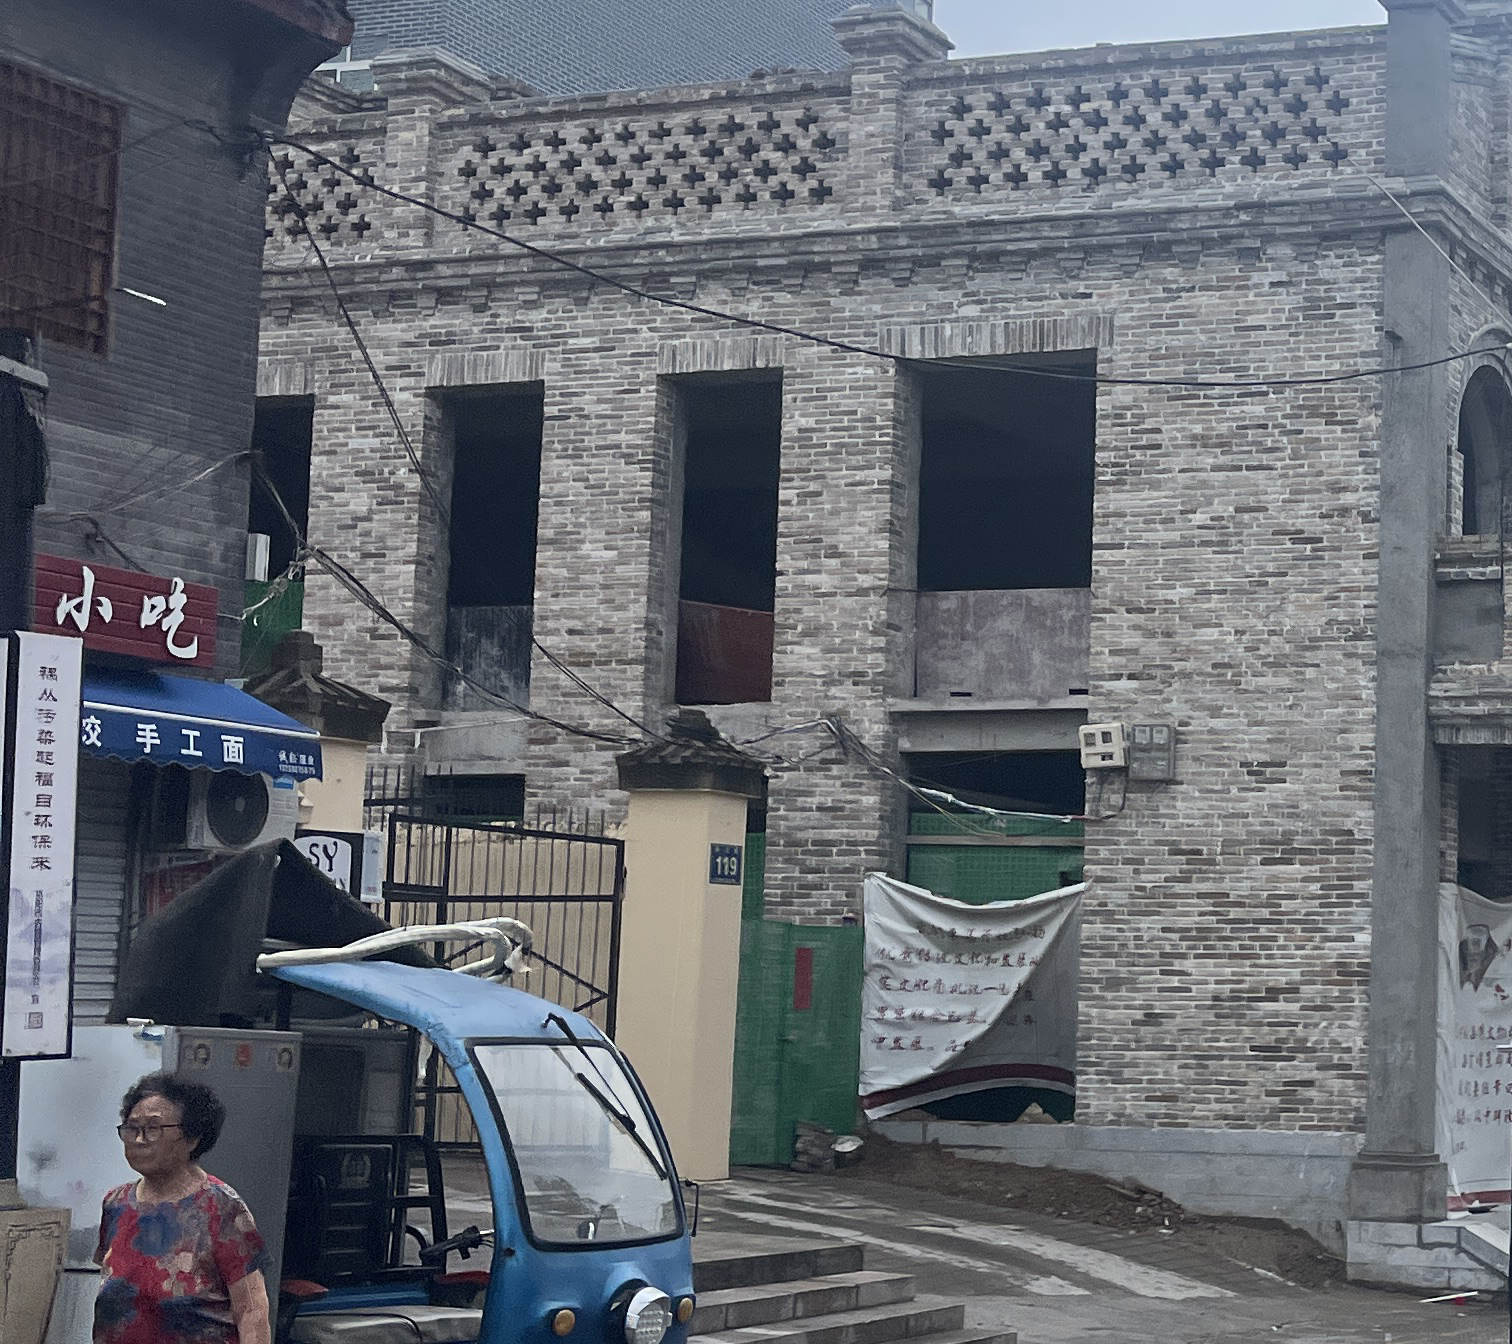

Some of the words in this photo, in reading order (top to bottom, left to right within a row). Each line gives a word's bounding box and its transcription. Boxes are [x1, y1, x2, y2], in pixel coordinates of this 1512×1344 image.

[57, 566, 198, 659] 小吃
[309, 840, 338, 873] SY
[715, 855, 737, 876] 119
